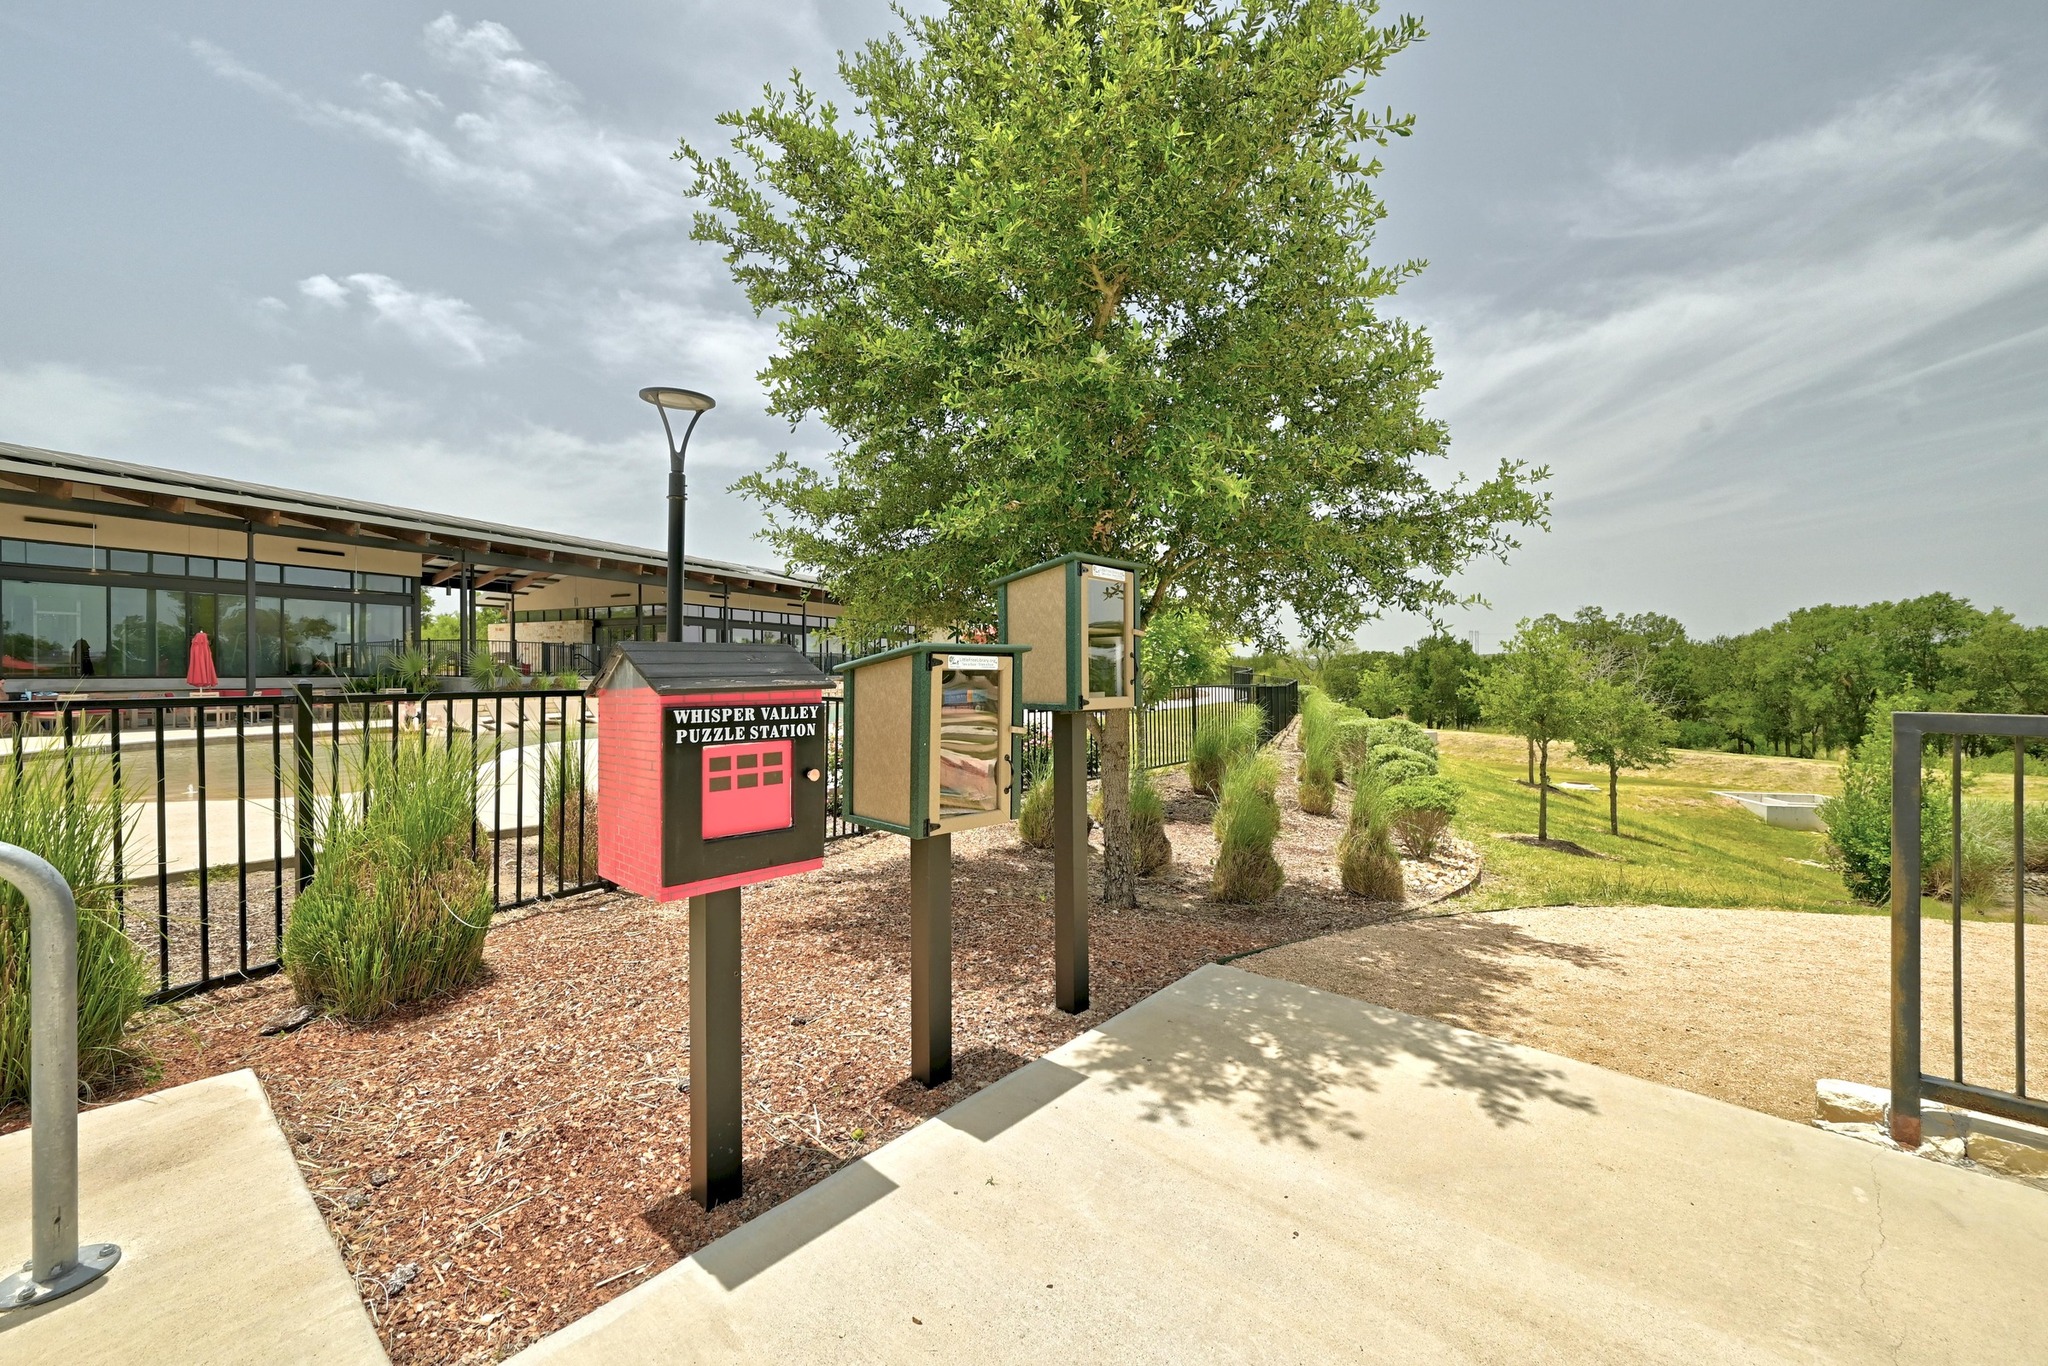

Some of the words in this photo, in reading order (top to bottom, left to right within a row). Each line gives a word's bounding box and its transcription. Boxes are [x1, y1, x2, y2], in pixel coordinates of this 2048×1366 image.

[674, 708, 756, 724] WHISPER
[761, 706, 819, 720] VALLEY
[676, 727, 746, 744] PUZZLE
[750, 723, 816, 740] STATION
